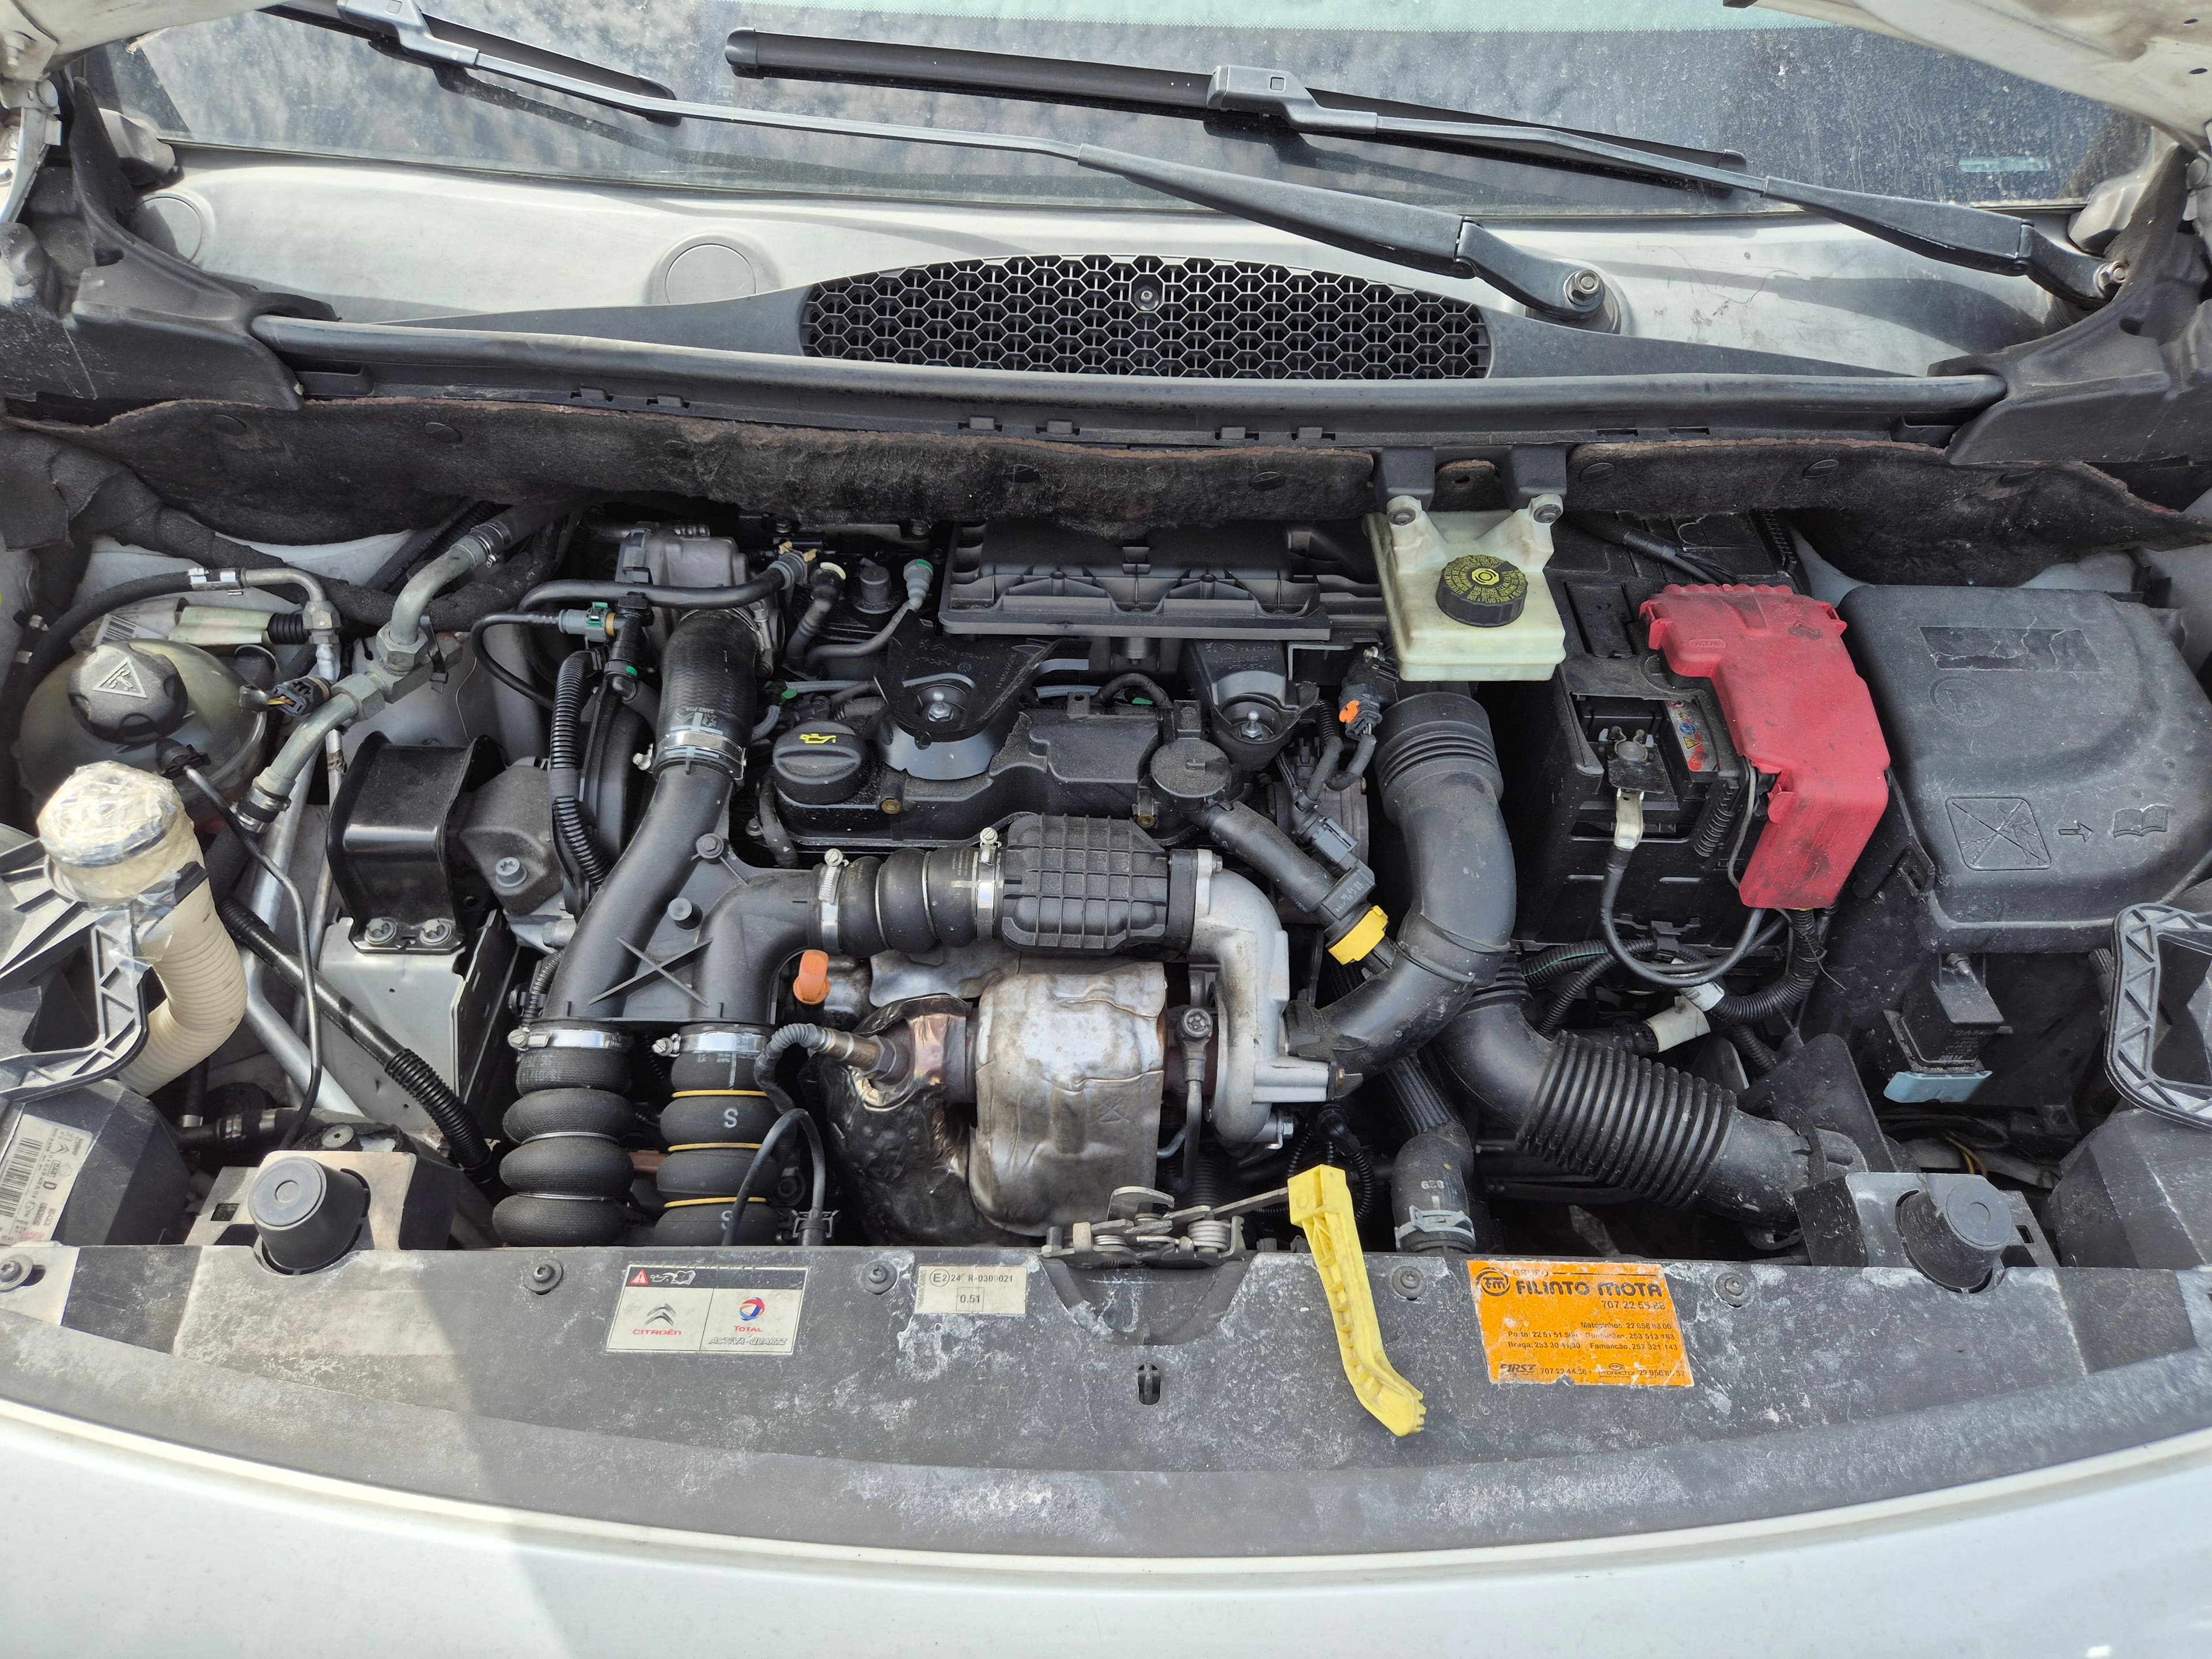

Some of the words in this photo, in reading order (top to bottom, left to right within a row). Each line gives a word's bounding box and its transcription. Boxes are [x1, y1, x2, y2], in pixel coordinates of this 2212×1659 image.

[724, 1108, 738, 1129] S
[1516, 1280, 1590, 1296] FILINTO
[1597, 1282, 1662, 1297] MOTA
[960, 1294, 980, 1303] 0.51
[1601, 1301, 1619, 1309] 707
[1623, 1301, 1636, 1309] 22
[1638, 1301, 1650, 1310] 55
[1499, 1363, 1536, 1373] FIRST
